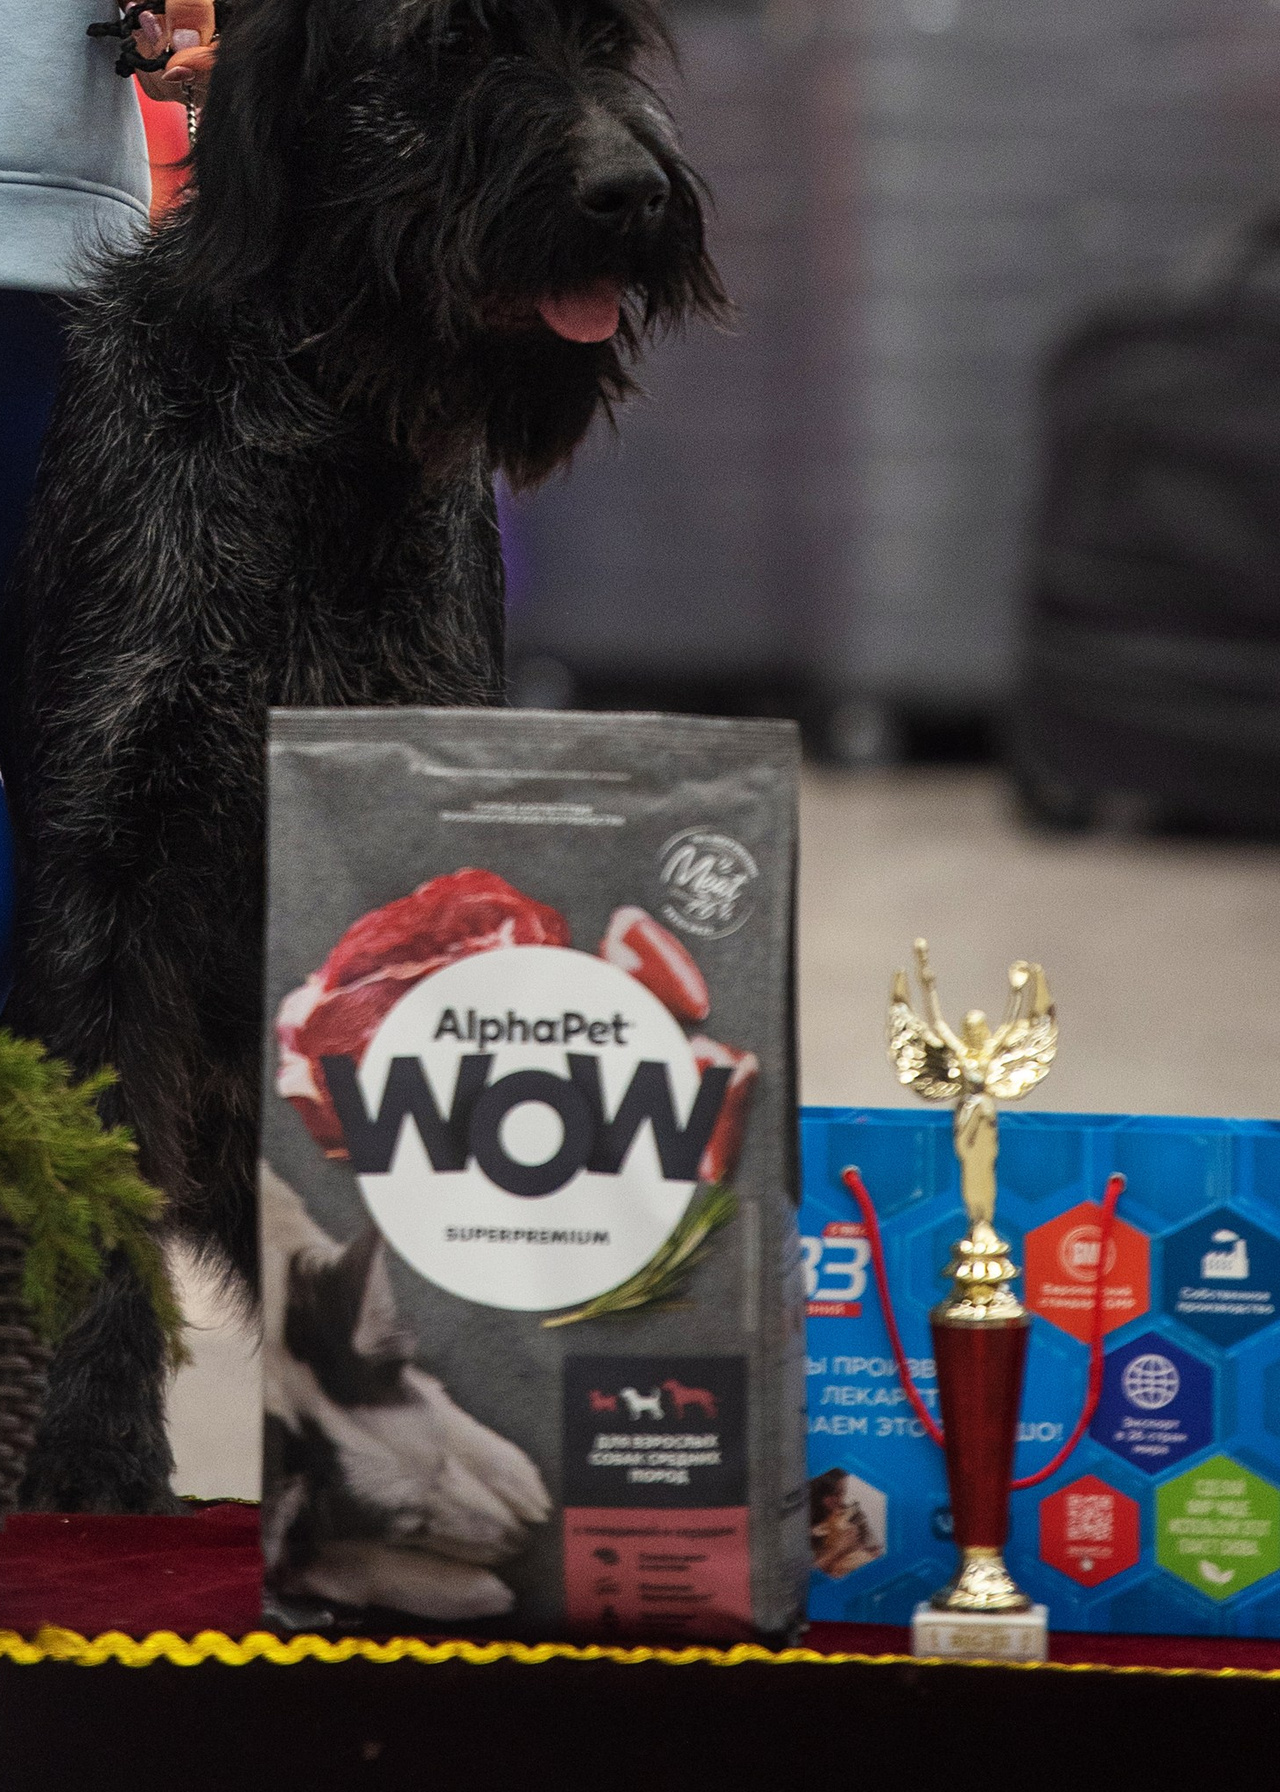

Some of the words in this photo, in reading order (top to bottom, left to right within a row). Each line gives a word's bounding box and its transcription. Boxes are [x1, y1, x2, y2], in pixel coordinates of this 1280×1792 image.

[434, 1008, 629, 1052] AlphaPet
[321, 1053, 733, 1198] WOW
[446, 1226, 610, 1245] SUPERPREMIUM
[808, 1415, 868, 1436] АЕМ
